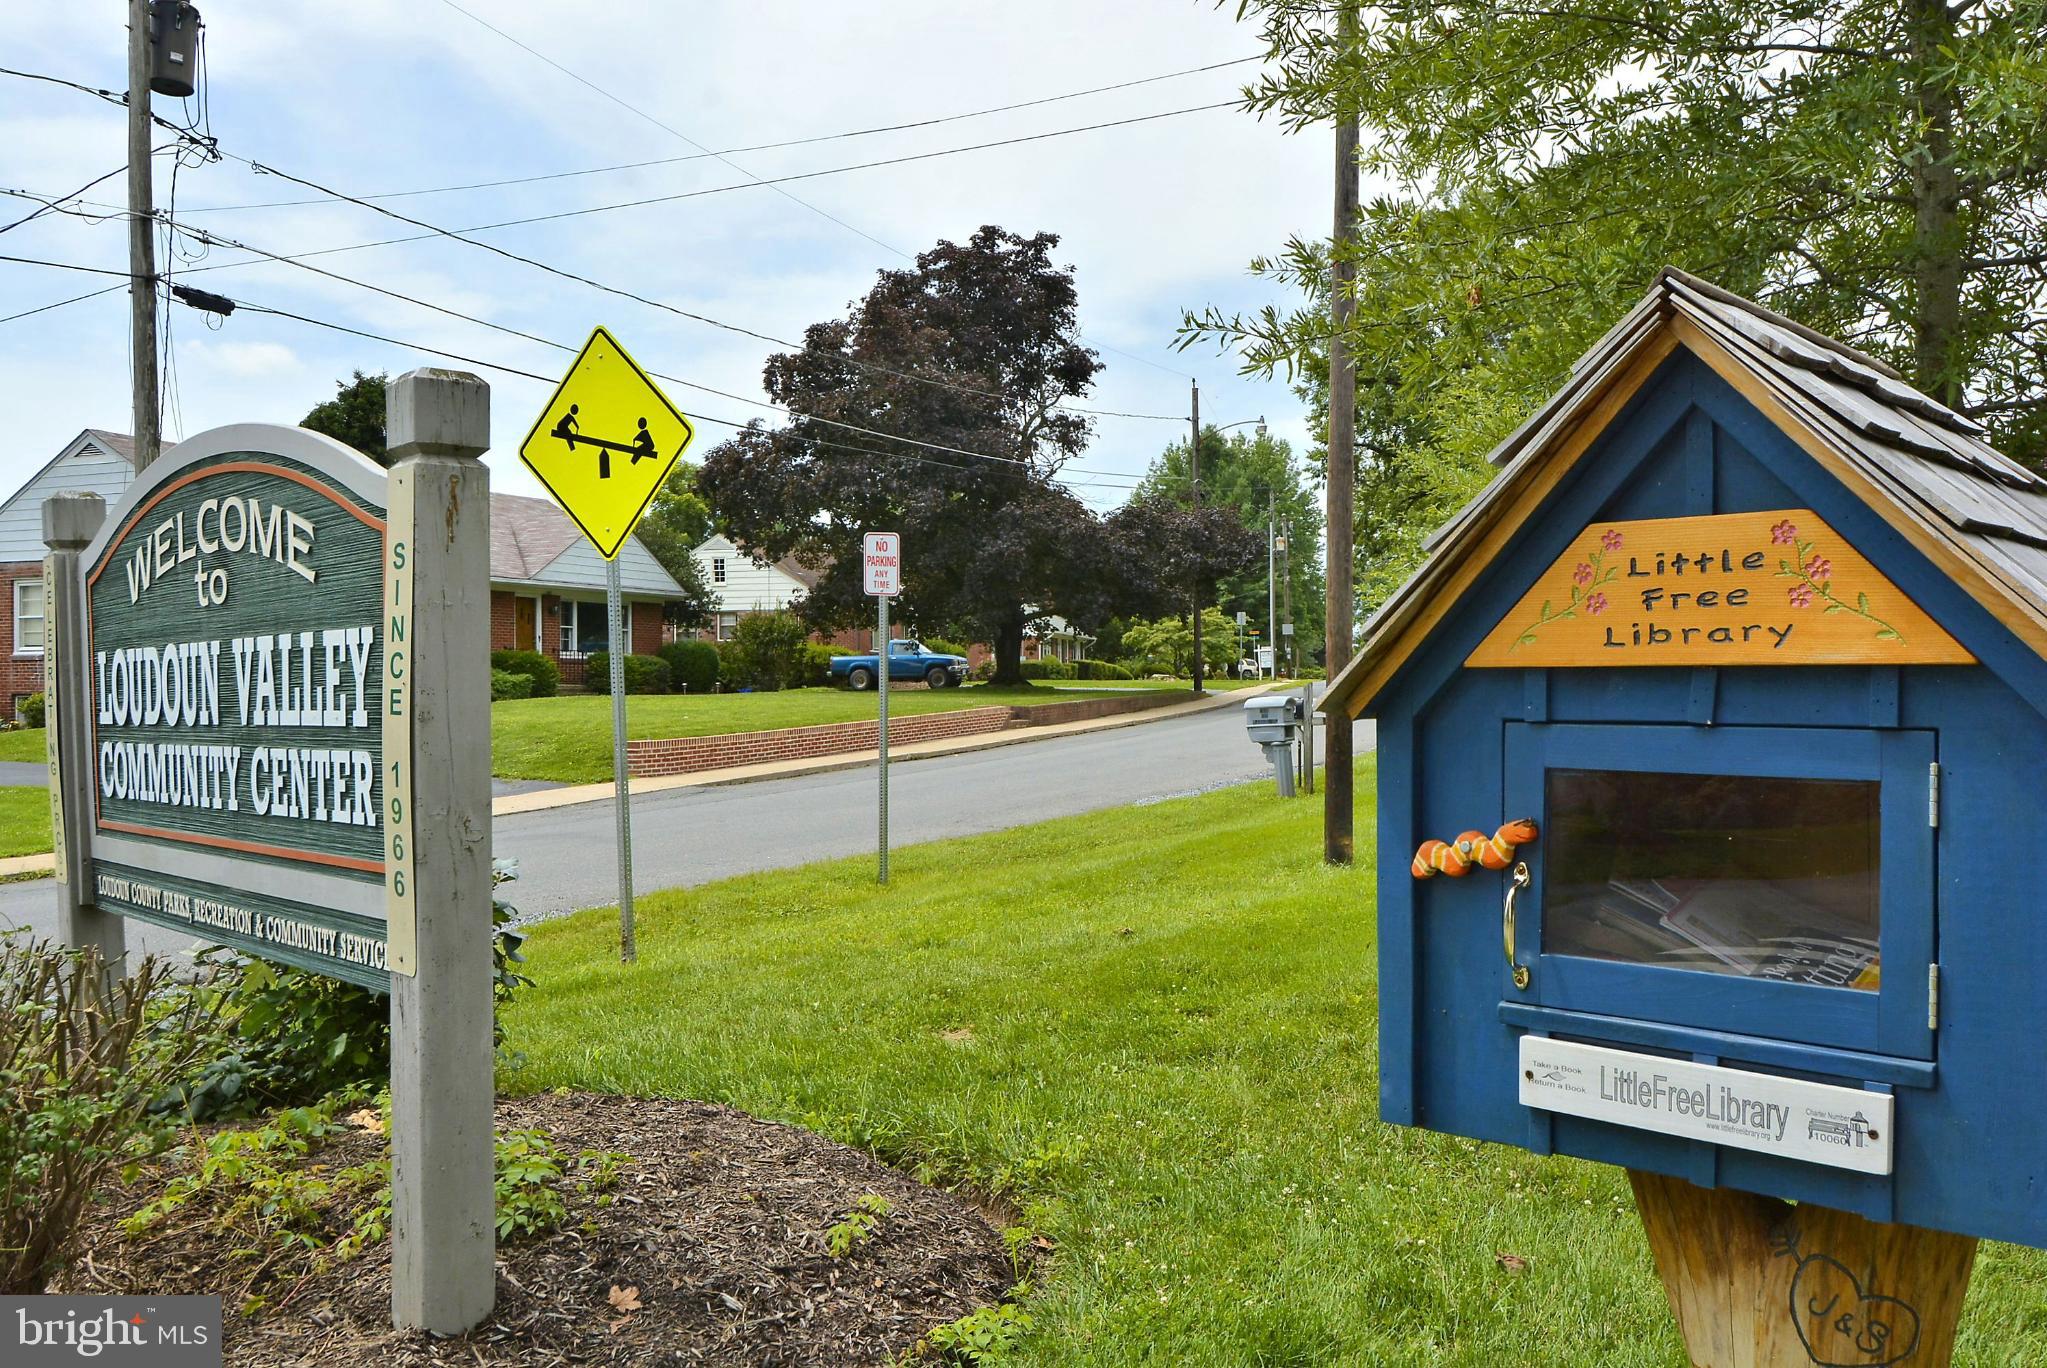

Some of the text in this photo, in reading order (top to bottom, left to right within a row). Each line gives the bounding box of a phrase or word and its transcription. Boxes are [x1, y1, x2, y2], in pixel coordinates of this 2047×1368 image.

[126, 496, 316, 605] WELCOME
[875, 541, 888, 552] NO
[867, 556, 896, 567] PARKING
[1627, 549, 1765, 577] Little
[194, 559, 229, 607] to
[874, 581, 890, 589] TIME
[1641, 587, 1749, 612] Free
[1603, 623, 1793, 649] Library
[98, 627, 374, 727] LOUDOUN VALLEY
[389, 542, 406, 897] SINCE 1966
[101, 742, 377, 826] COMMUNITY CENTER
[98, 875, 130, 901] LOUDOUN
[131, 883, 161, 910] COUNTY
[162, 890, 192, 923] PARKS,
[194, 898, 253, 936] RECREATION
[255, 913, 264, 939] &
[266, 915, 337, 957] COMMUNITY
[1532, 1060, 1552, 1069] Take
[1561, 1065, 1582, 1074] Book
[1565, 1083, 1586, 1093] Book
[1600, 1065, 1790, 1142] LittleFreeLibrary
